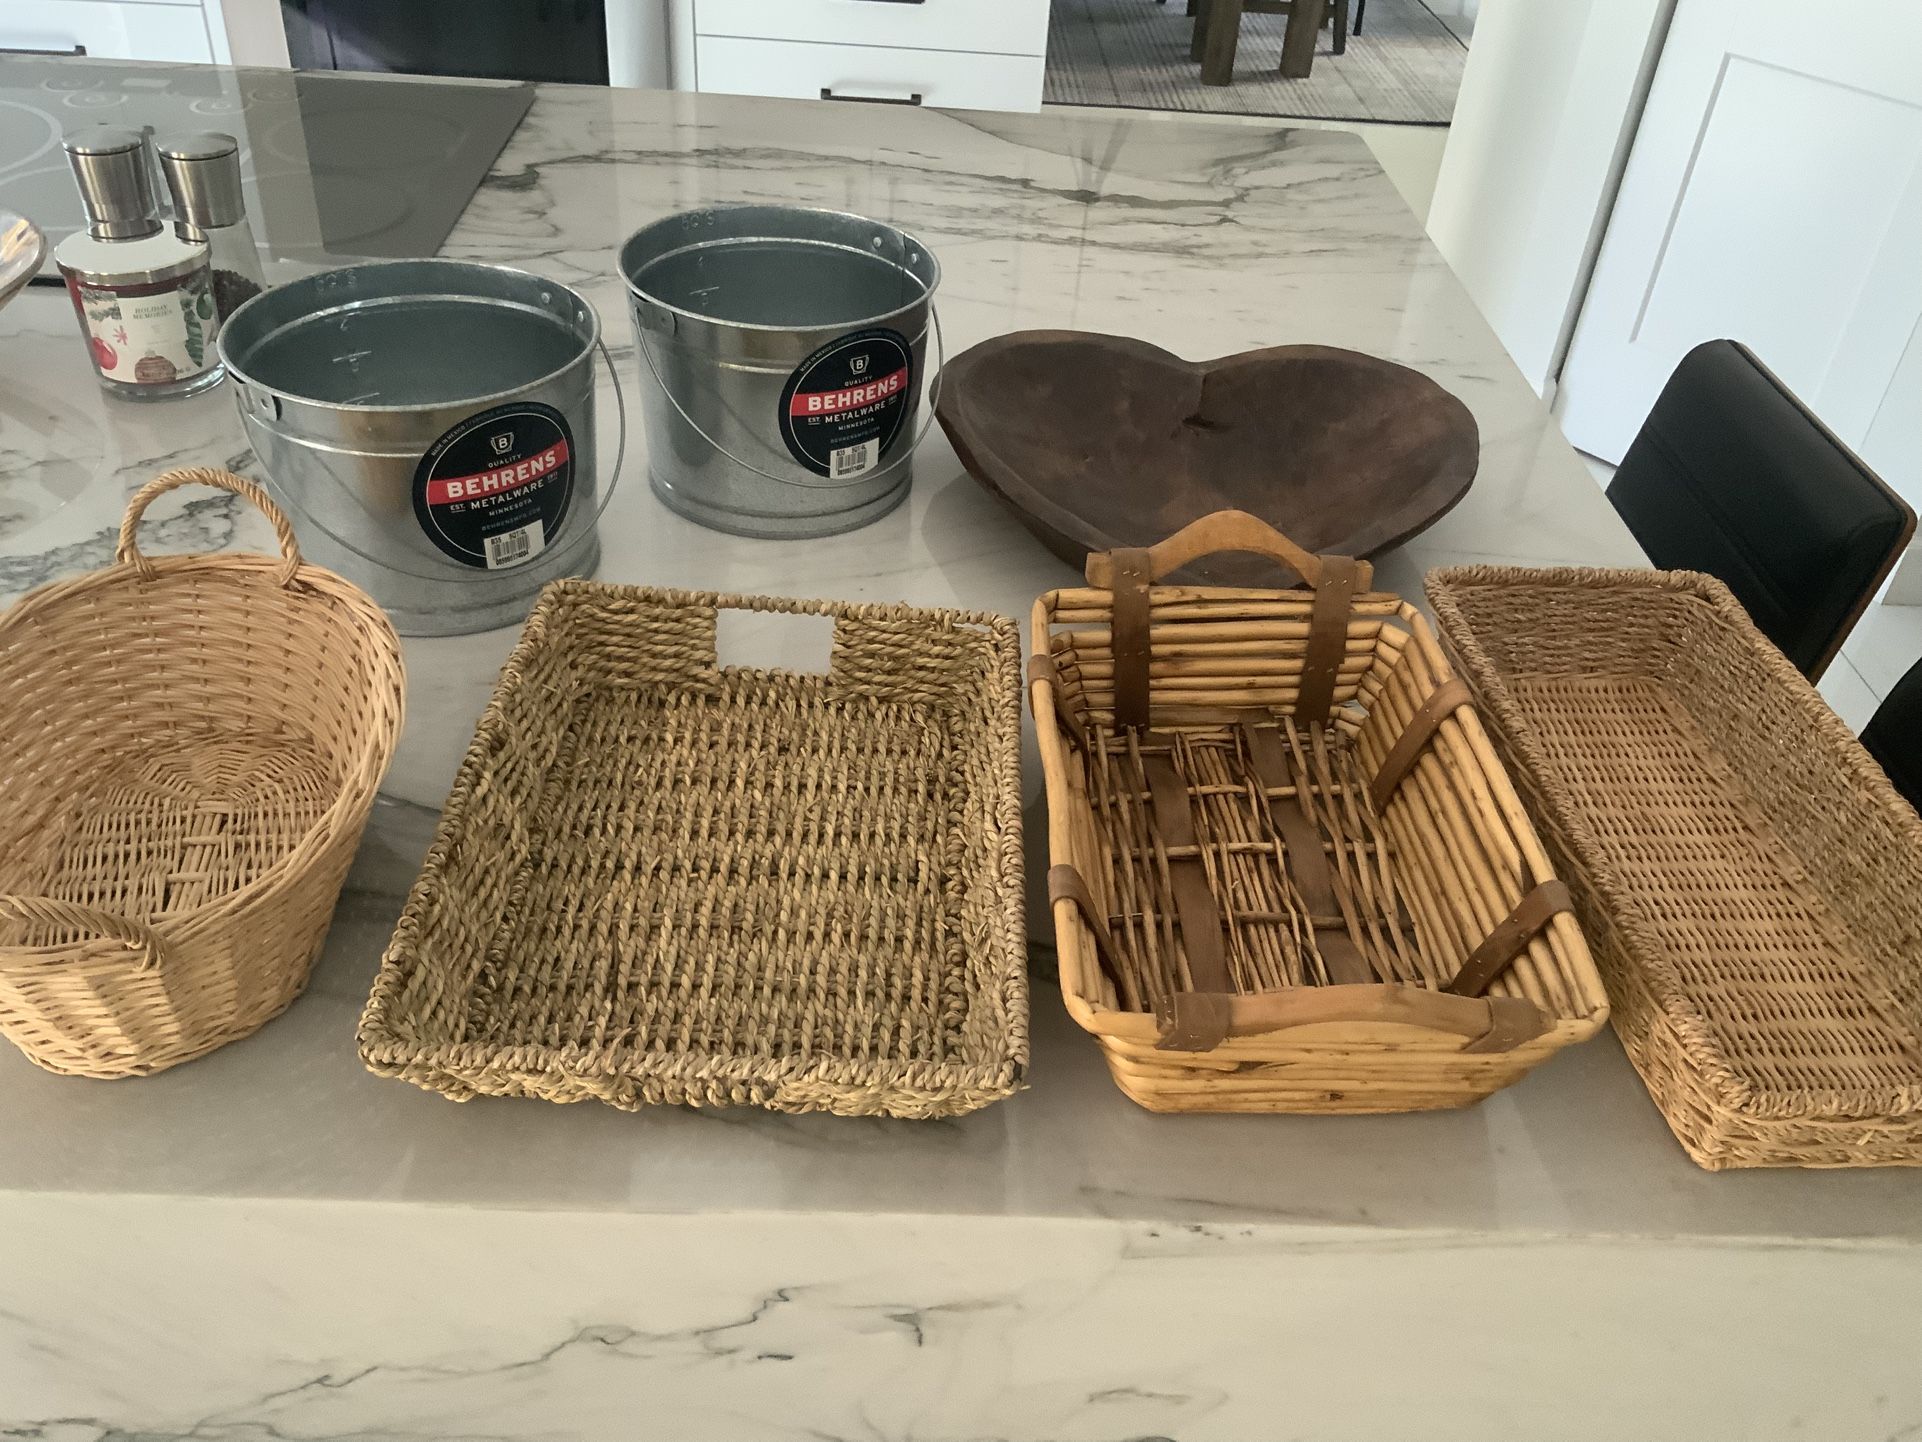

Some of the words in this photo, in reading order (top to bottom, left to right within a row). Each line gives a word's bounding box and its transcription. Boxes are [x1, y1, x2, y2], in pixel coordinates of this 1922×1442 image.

[133, 309, 173, 320] MEMORIES
[135, 304, 168, 314] HOLIDAY
[844, 375, 873, 387] QUALITY
[808, 375, 898, 411] BEHRENS
[824, 401, 885, 424] METALWARE
[838, 417, 875, 431] MINNESOTA
[488, 453, 522, 469] QUALITY
[447, 450, 556, 498] BEHRENS
[470, 479, 545, 510] METALWARE
[489, 498, 533, 516] MINNESOTA
